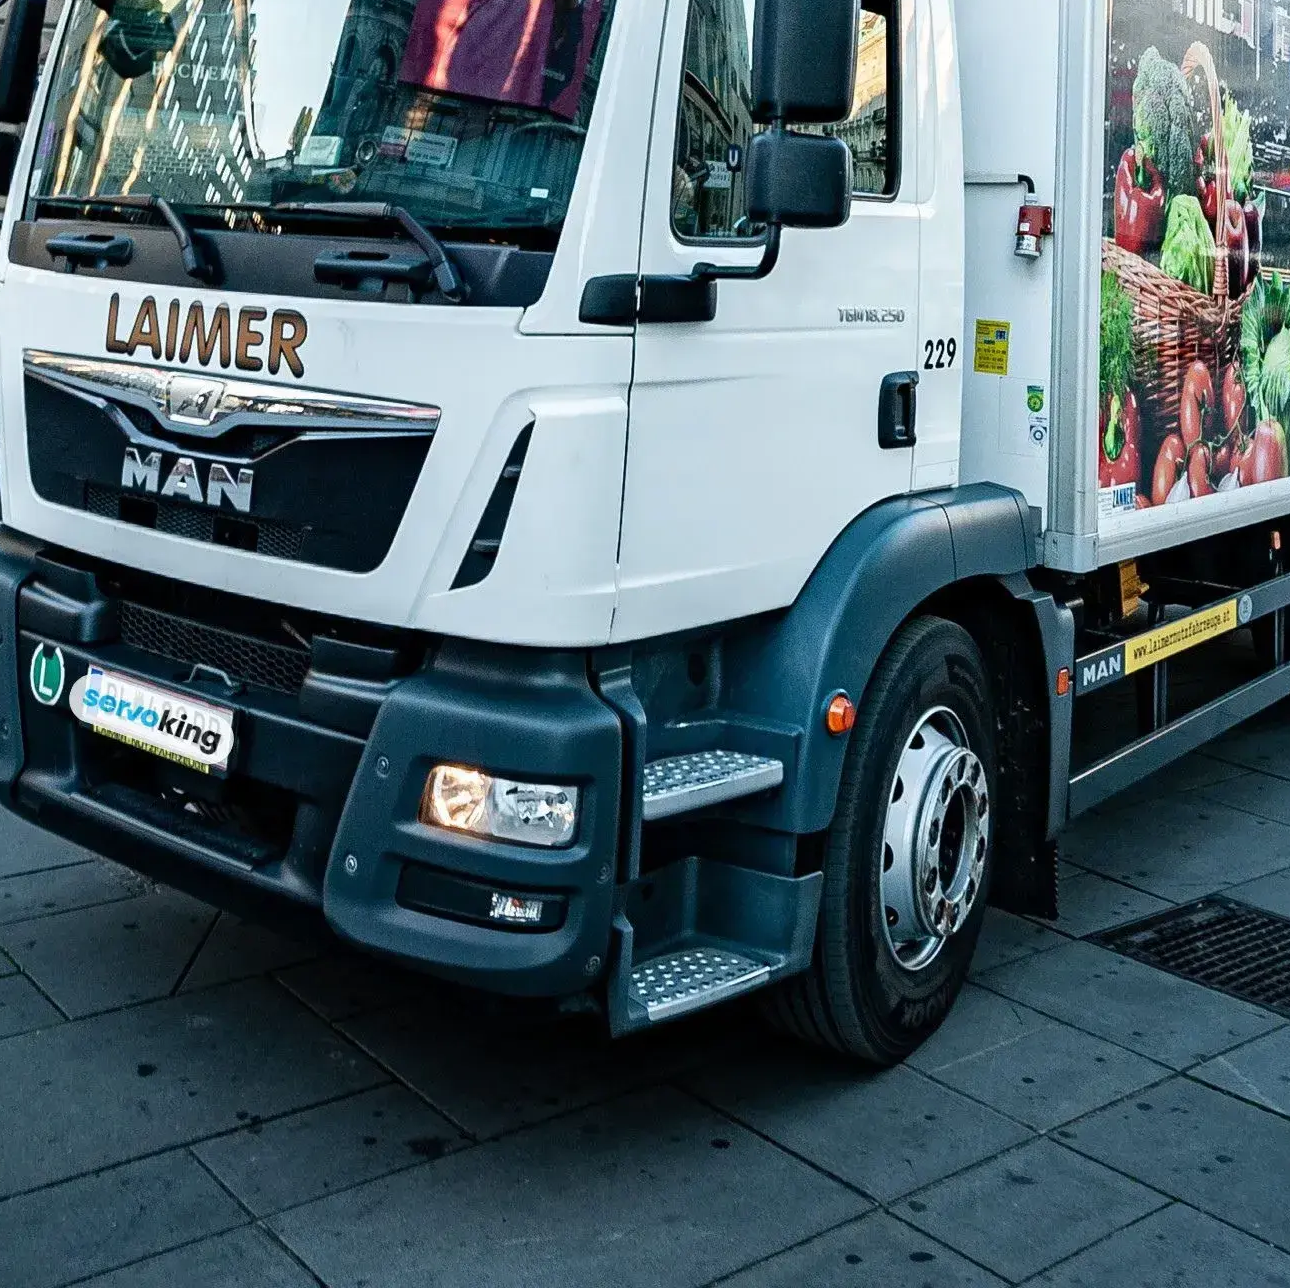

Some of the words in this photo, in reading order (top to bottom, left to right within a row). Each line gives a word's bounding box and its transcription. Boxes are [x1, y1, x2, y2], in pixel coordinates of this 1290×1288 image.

[105, 292, 309, 379] LAIMER
[923, 337, 957, 370] 229
[120, 446, 254, 513] MAN
[38, 656, 53, 698] L
[1082, 653, 1122, 687] MAN
